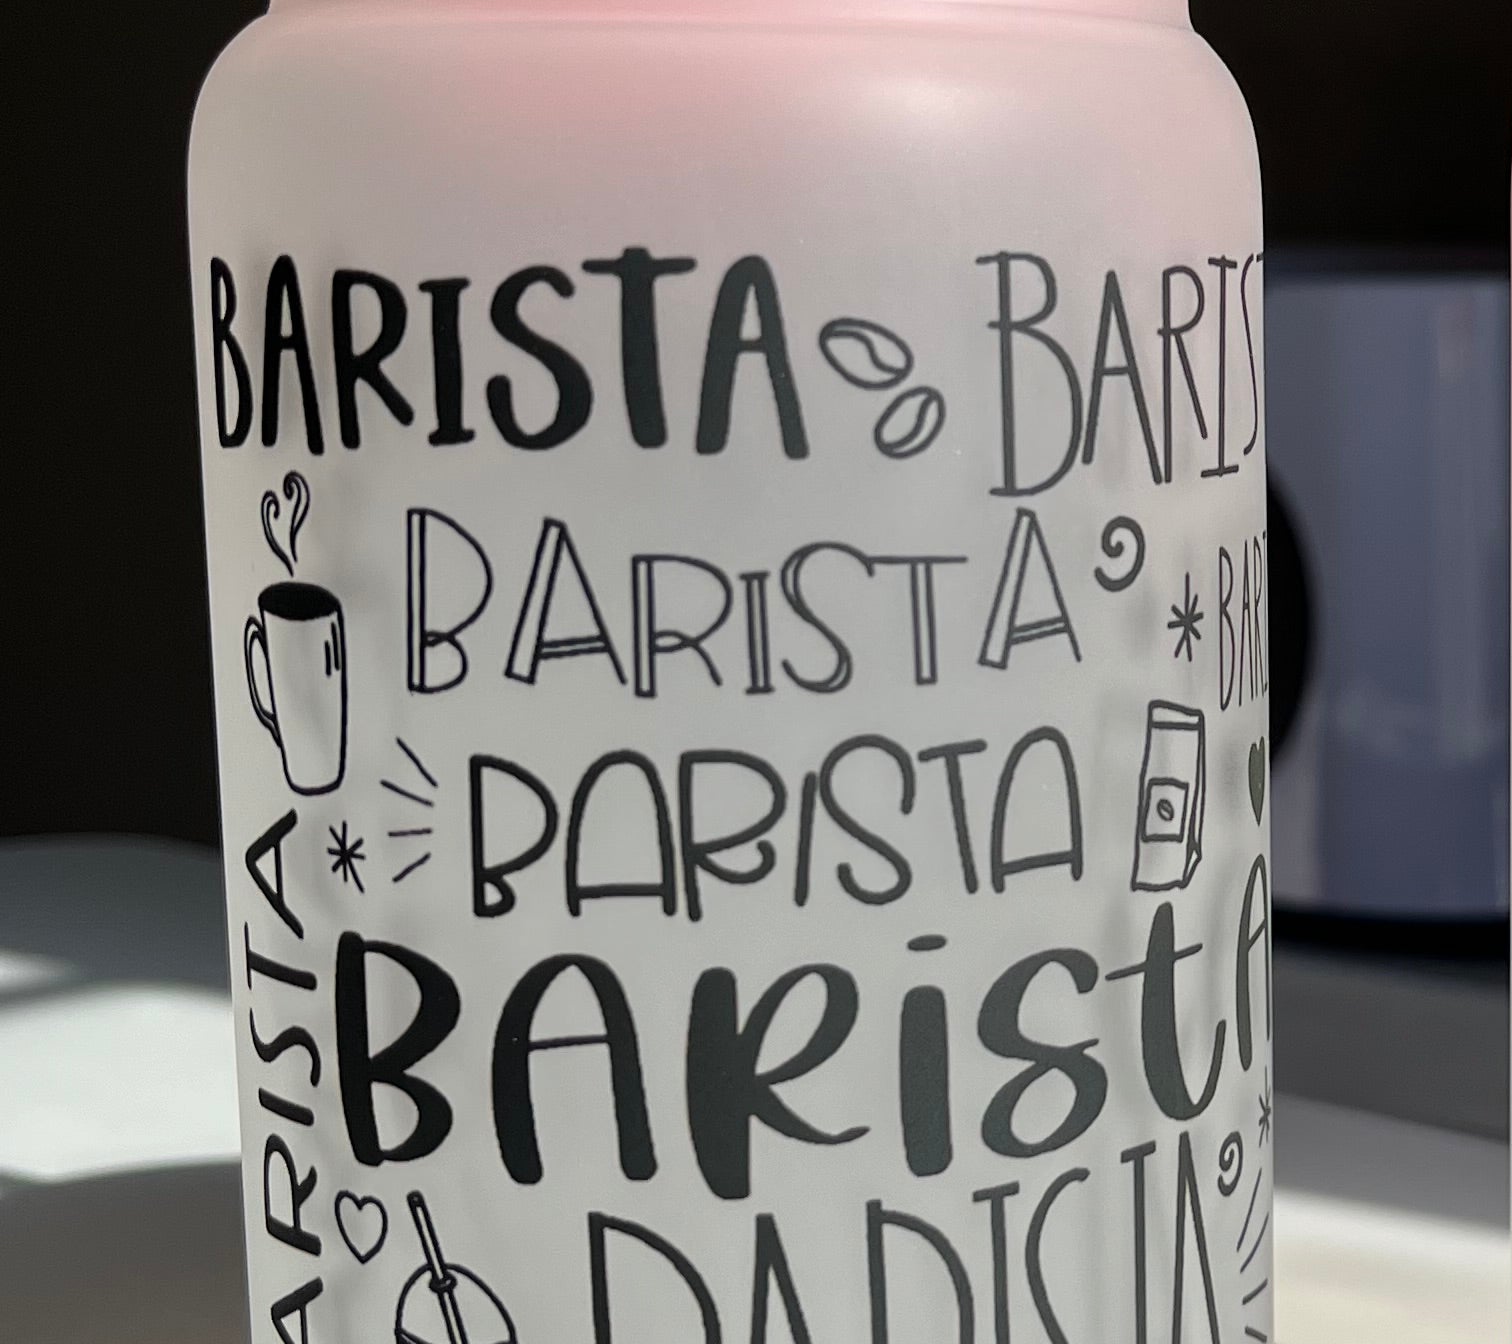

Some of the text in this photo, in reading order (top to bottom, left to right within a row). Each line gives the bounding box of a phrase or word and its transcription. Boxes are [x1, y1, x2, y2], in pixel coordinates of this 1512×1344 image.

[210, 246, 809, 459] BARISTA
[976, 251, 1264, 497] BARIS
[406, 507, 1082, 699] BARISTA
[469, 726, 1082, 921] BARISTA
